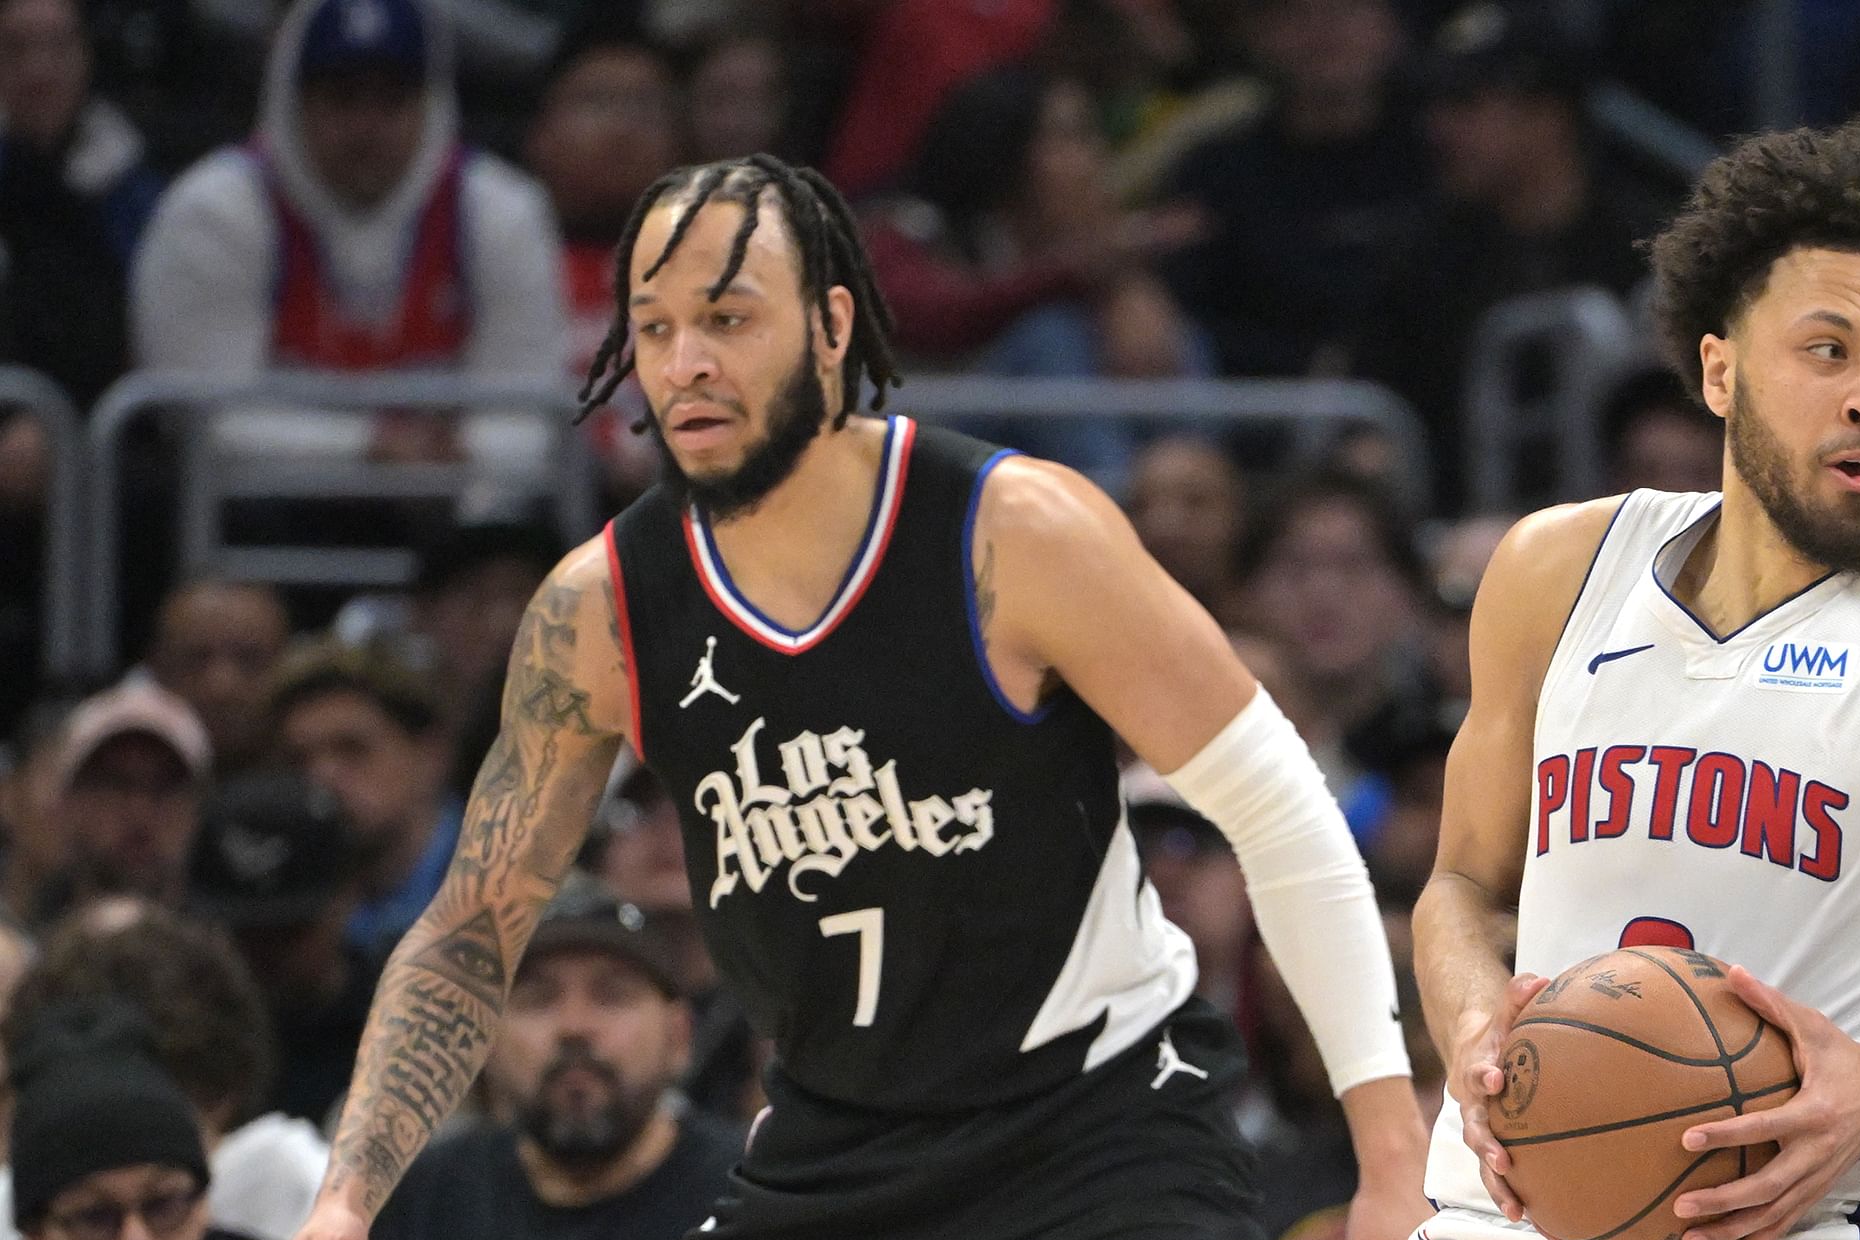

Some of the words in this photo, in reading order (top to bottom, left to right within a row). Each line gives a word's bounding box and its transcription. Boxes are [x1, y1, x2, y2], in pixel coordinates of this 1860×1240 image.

[1763, 643, 1849, 677] UWM
[730, 716, 873, 798] Los
[1537, 745, 1850, 882] PISTONS
[694, 758, 994, 909] Angeles
[818, 906, 884, 1027] 7
